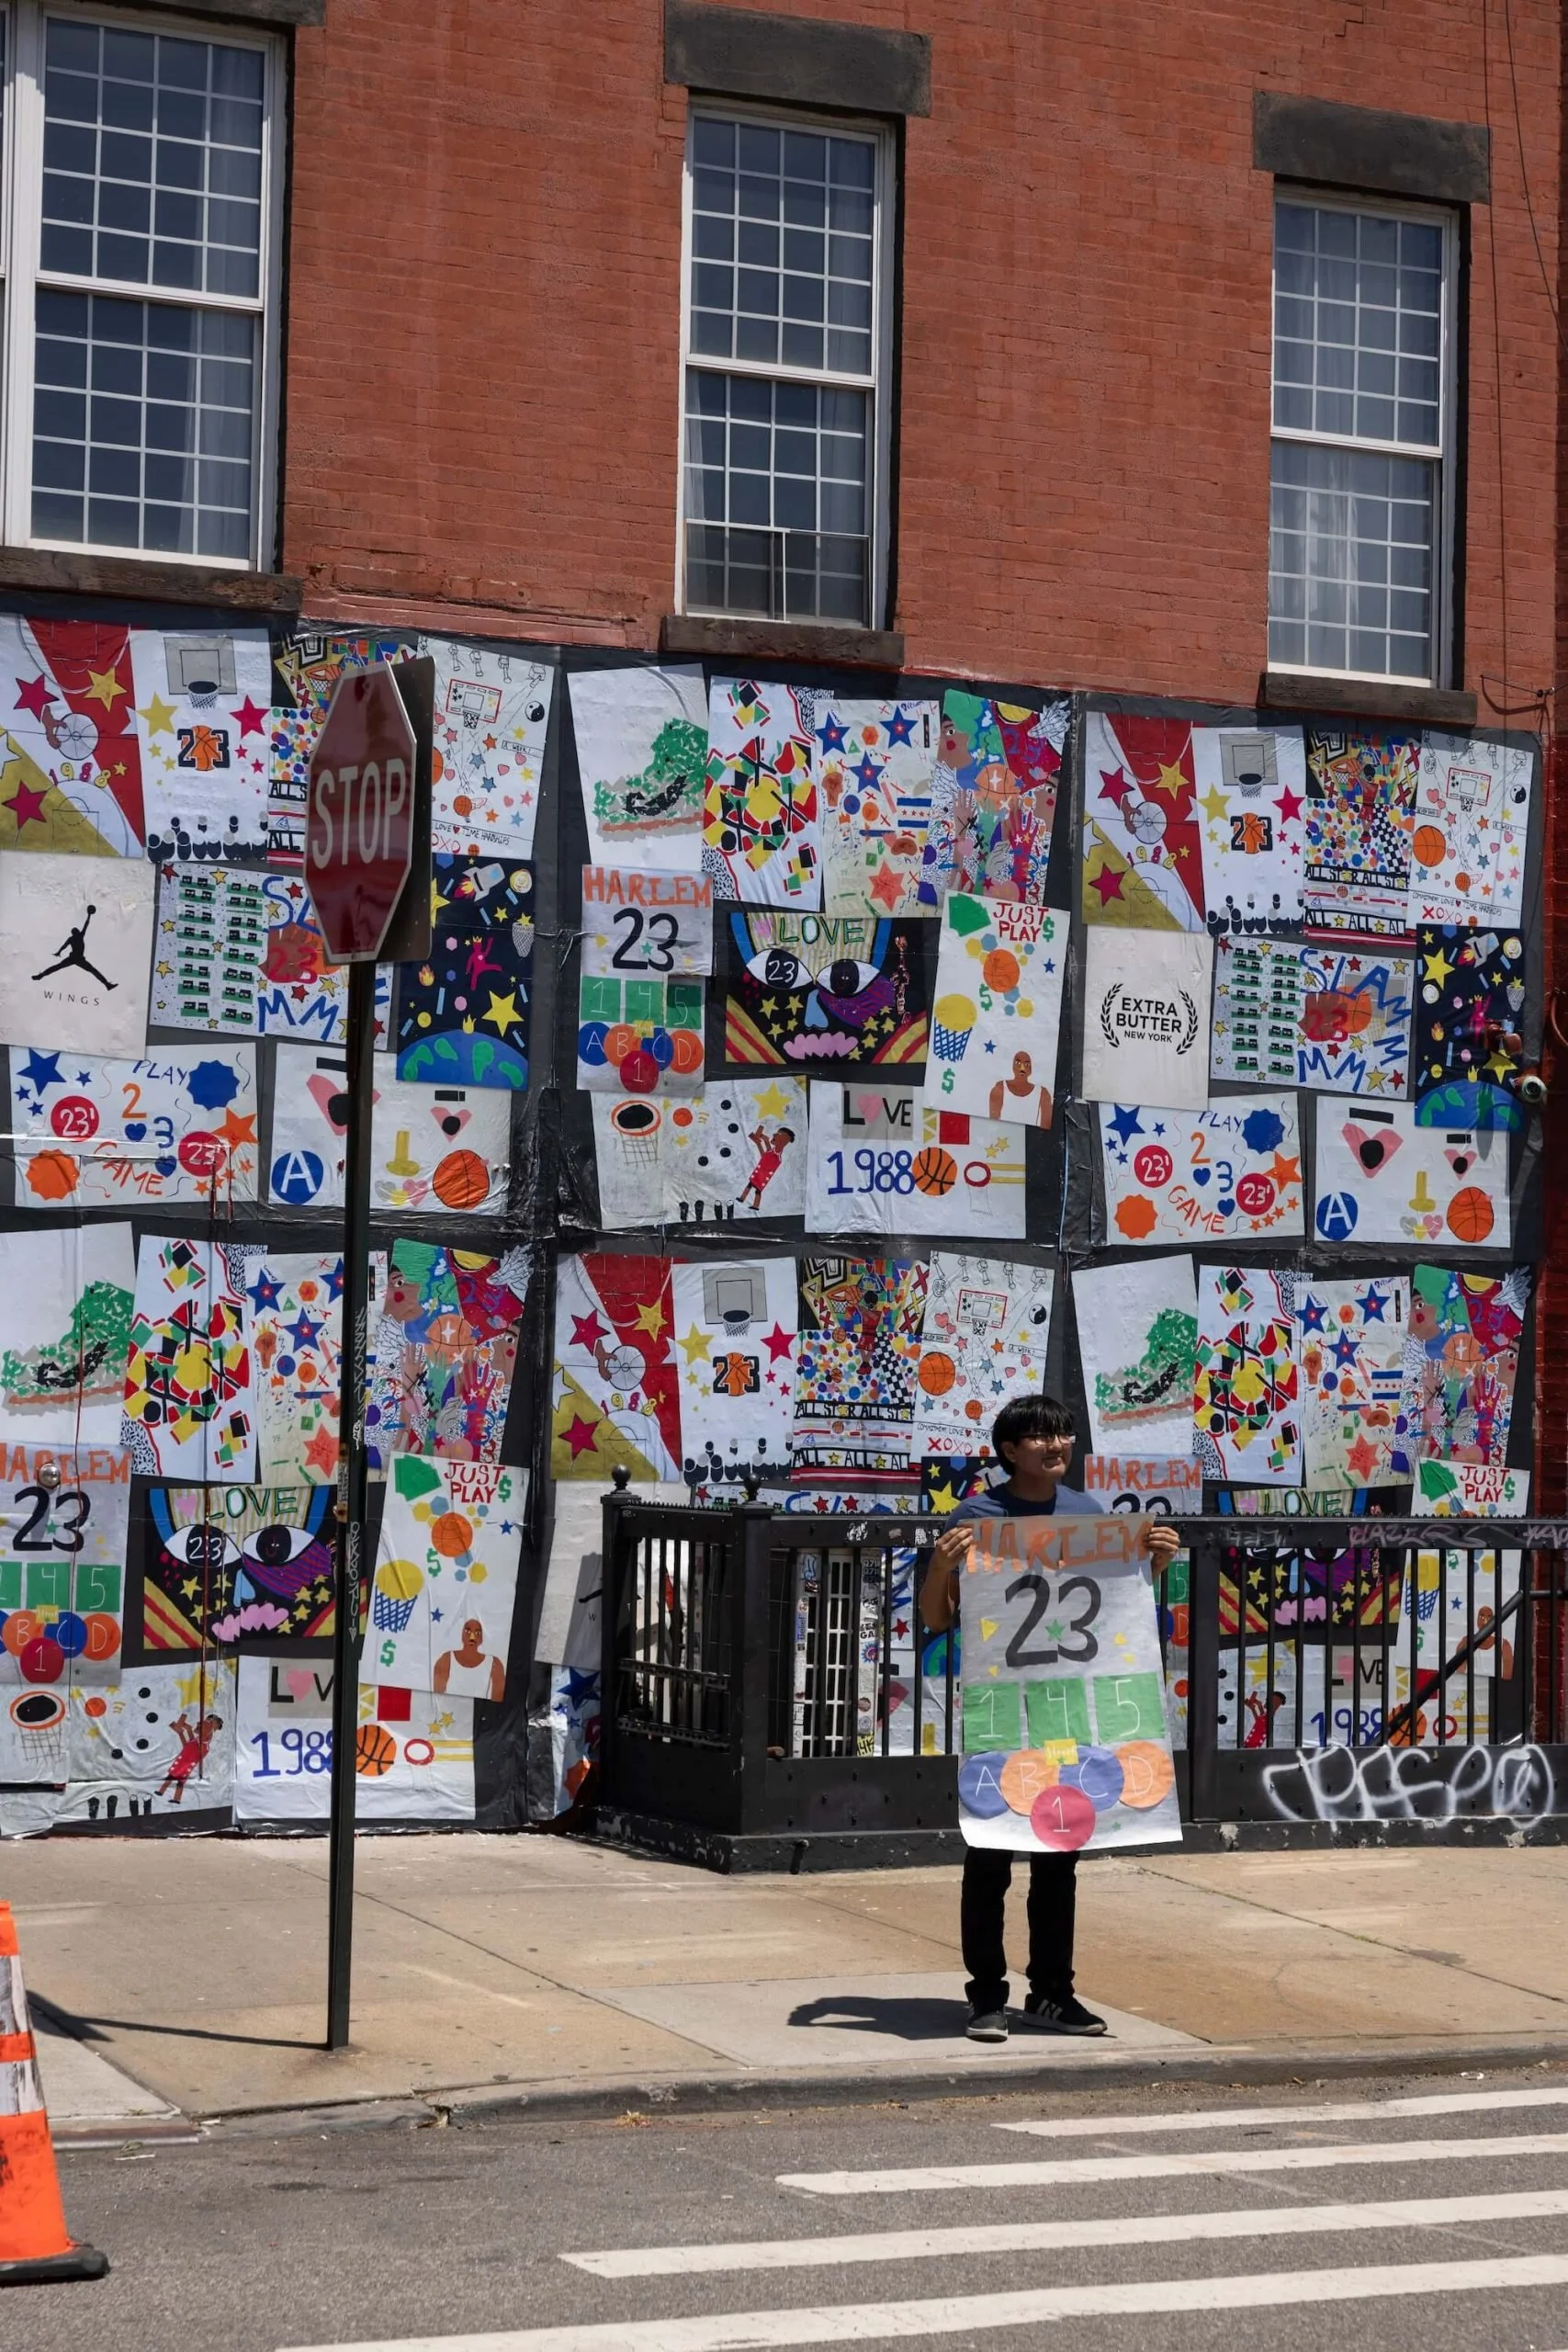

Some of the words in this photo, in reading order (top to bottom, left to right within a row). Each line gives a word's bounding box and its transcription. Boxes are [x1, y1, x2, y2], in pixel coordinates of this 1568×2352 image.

[176, 729, 230, 768] 23
[49, 762, 111, 788] 1988
[311, 758, 406, 869] STOP
[1230, 816, 1273, 852] 23
[1127, 845, 1178, 870] 1988
[582, 866, 714, 908] HARLEM
[993, 902, 1049, 926] JUST
[1422, 905, 1462, 924] XOXO
[612, 908, 679, 972] 23
[780, 915, 864, 944] LOVE
[998, 921, 1042, 943] PLAY
[767, 960, 795, 983] 23
[43, 990, 100, 1007] WINGS
[1122, 997, 1178, 1017] EXTRA
[1116, 1012, 1182, 1034] BUTTER
[1124, 1030, 1145, 1040] NEW
[1148, 1033, 1173, 1044] YORK
[132, 1059, 189, 1086] PLAY
[1198, 1111, 1243, 1133] PLAY
[94, 1141, 164, 1196] GAME
[280, 1151, 317, 1193] A
[827, 1148, 917, 1194] 1988
[1168, 1185, 1225, 1234] GAME
[1324, 1193, 1353, 1231] A
[713, 1355, 761, 1394] 23
[600, 1392, 658, 1418] 1988
[928, 1437, 973, 1456] XOXO
[444, 1461, 505, 1485] JUST
[1087, 1457, 1203, 1492] HARLEM
[1460, 1465, 1510, 1486] JUST
[450, 1481, 497, 1504] PLAY
[1264, 1489, 1342, 1515] LOVE
[1464, 1483, 1504, 1503] PLAY
[13, 1487, 91, 1552] 23
[188, 1536, 222, 1561] 23
[966, 1520, 1154, 1574] HARLEM
[797, 1615, 806, 1640] Belief
[1005, 1574, 1101, 1668] 23
[251, 1728, 333, 1777] 198
